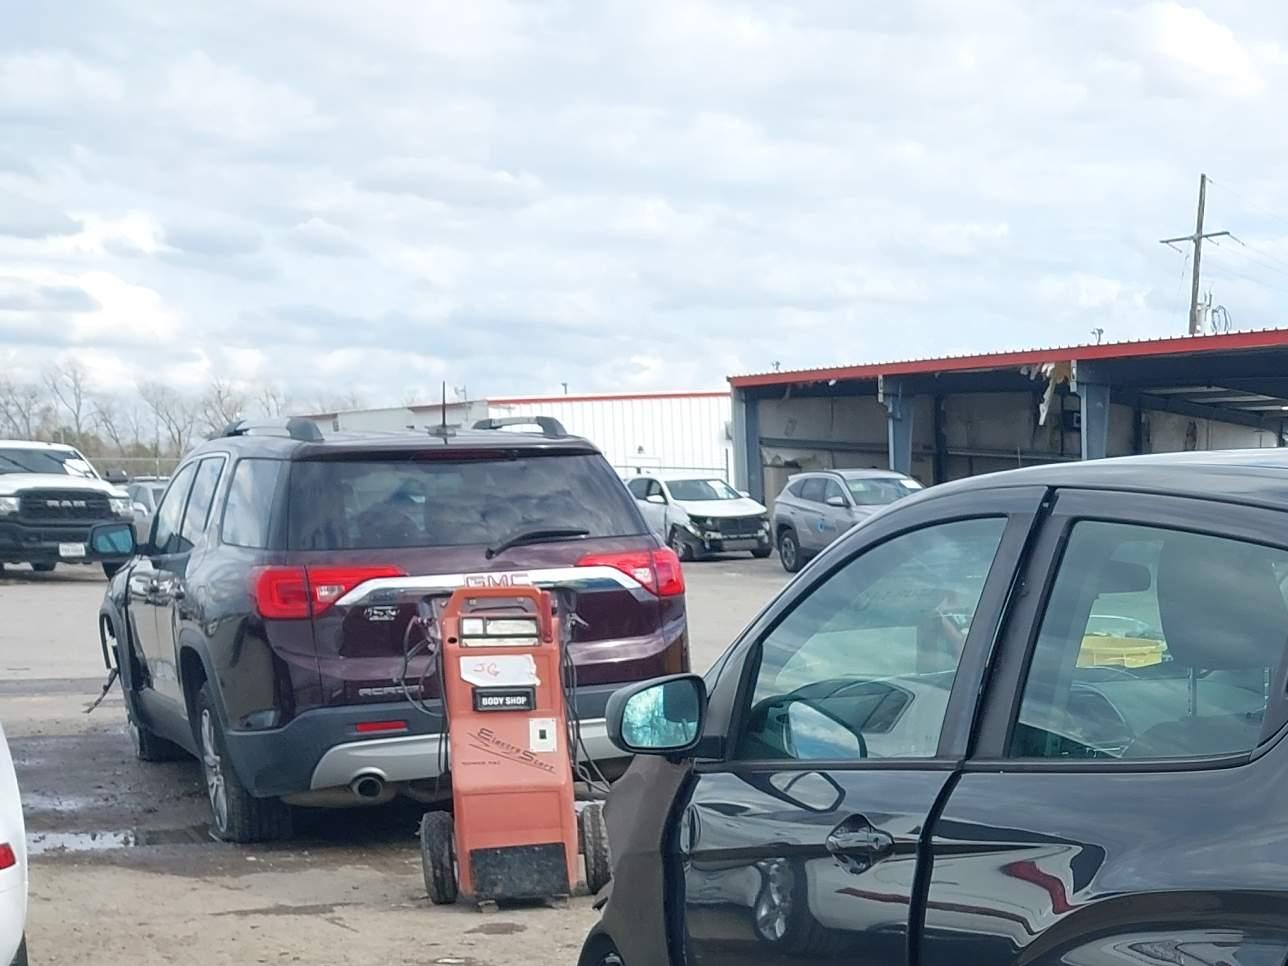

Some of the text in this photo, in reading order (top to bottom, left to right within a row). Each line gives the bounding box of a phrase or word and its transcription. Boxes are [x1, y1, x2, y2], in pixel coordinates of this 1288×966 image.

[466, 573, 528, 587] GMC
[482, 696, 527, 706] BODY SHOP
